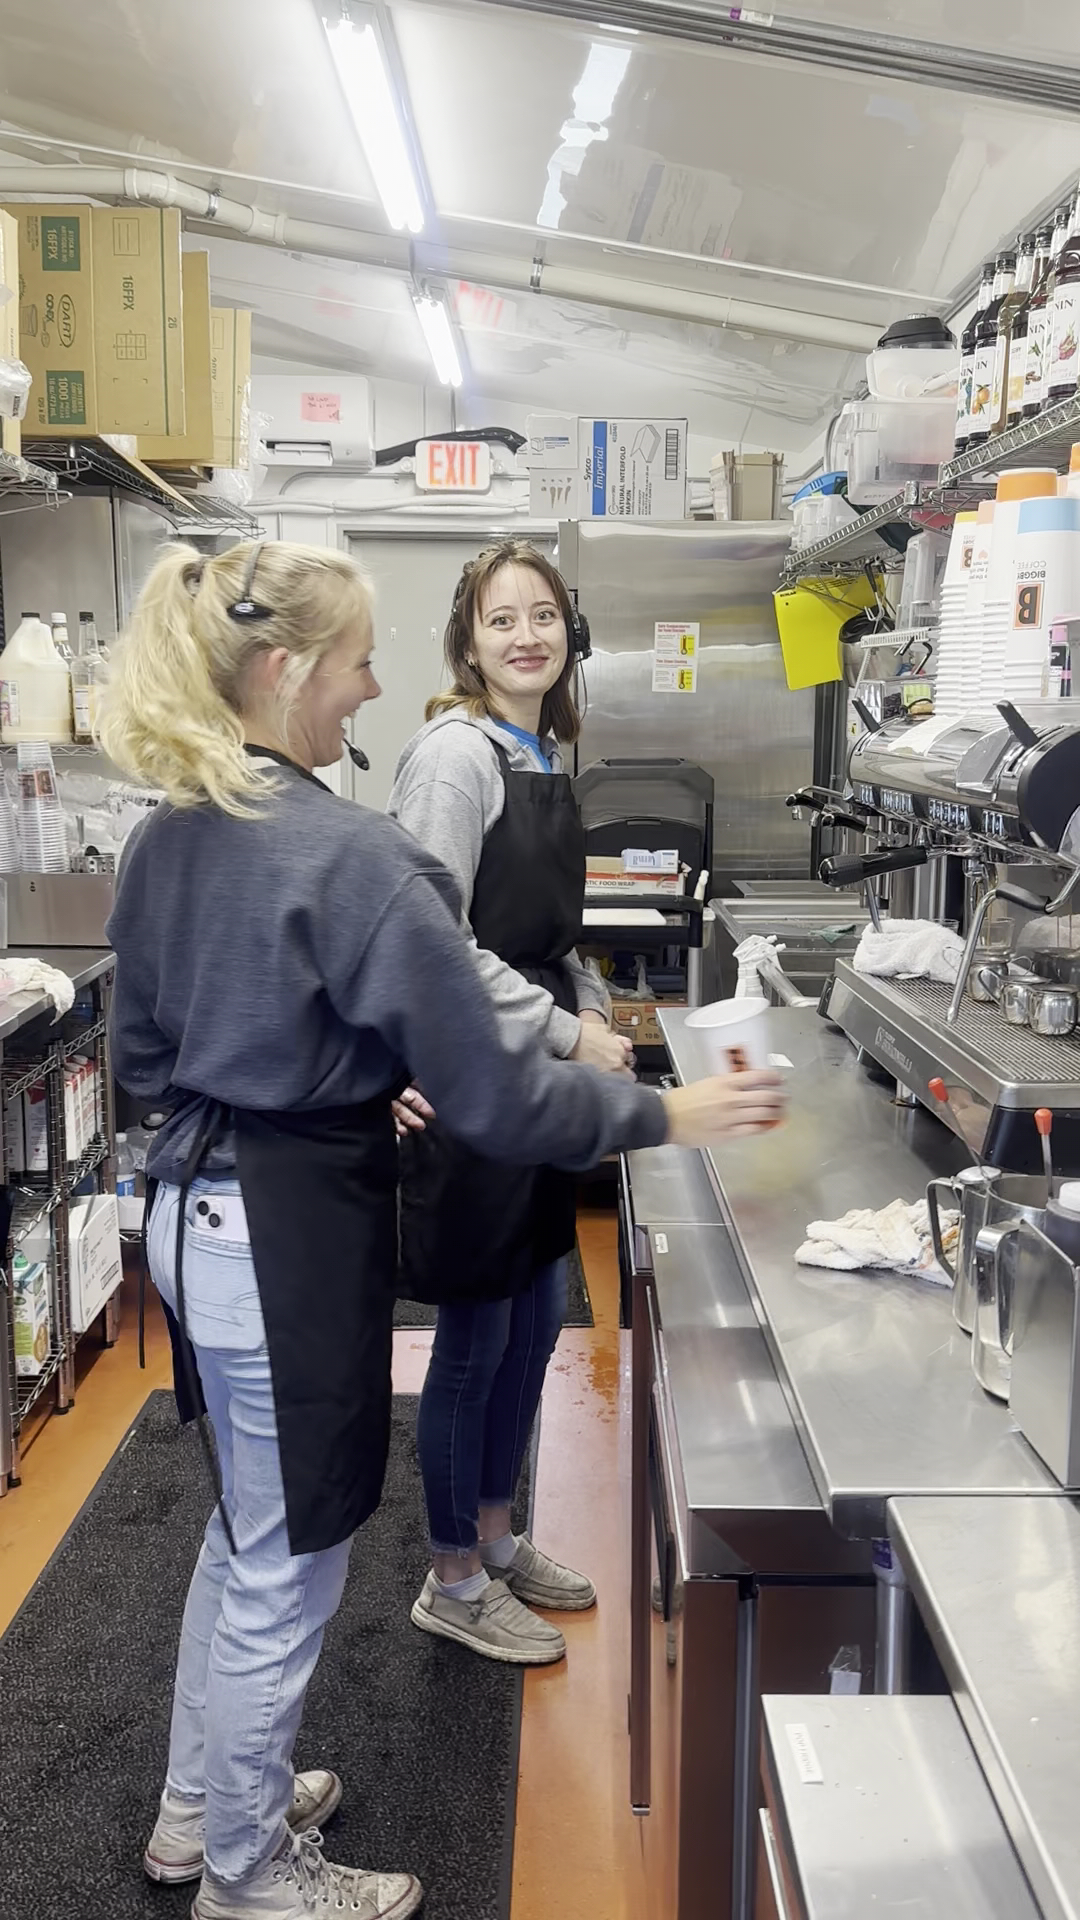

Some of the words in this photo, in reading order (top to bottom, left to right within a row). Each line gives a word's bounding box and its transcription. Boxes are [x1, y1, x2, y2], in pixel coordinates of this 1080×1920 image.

[47, 228, 58, 260] 16FPX
[122, 275, 135, 311] 16FPX
[62, 301, 72, 341] DART
[167, 316, 178, 329] 26
[58, 376, 69, 400] 1000
[429, 443, 480, 485] EXIT
[584, 458, 592, 481] Sysco
[594, 446, 606, 489] Imperial
[1018, 587, 1038, 624] B
